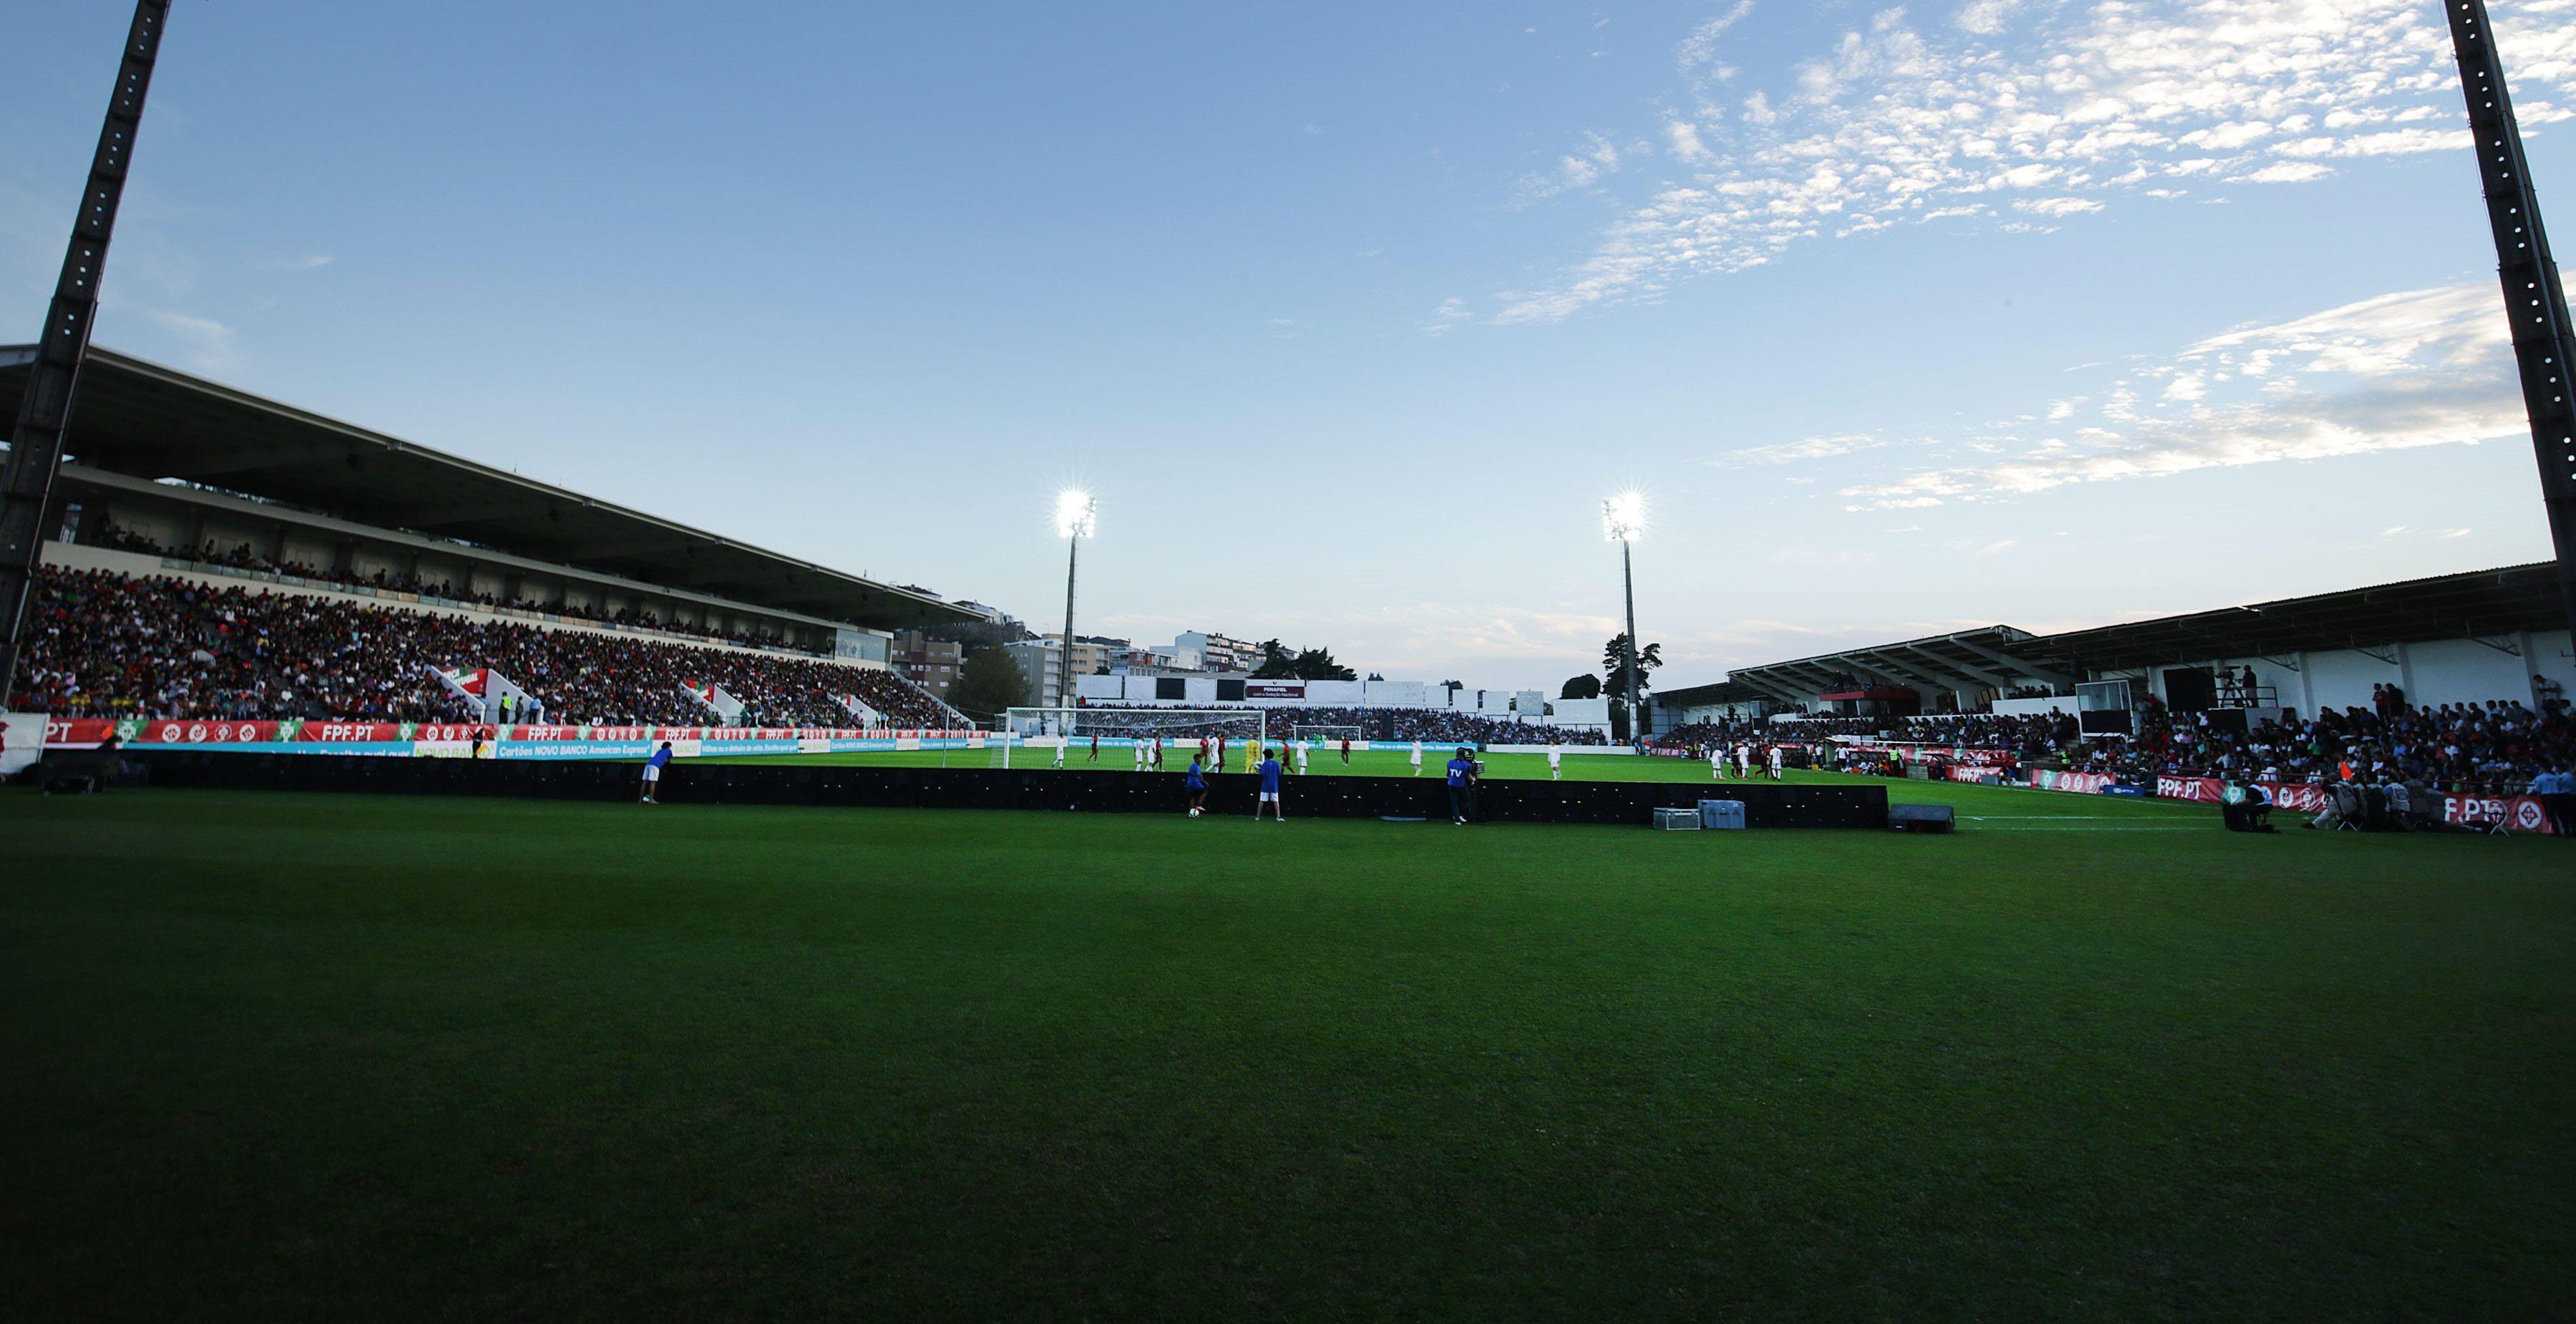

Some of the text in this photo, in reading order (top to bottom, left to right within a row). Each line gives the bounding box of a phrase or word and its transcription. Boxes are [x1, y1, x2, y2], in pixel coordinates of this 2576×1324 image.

[322, 724, 374, 741] FPF.PT
[528, 726, 562, 741] FPF.PT
[665, 729, 691, 740] FPF.PT
[766, 729, 784, 739] FPF.PT
[416, 748, 491, 758] NOVO BANO
[499, 745, 533, 756] Cartões
[535, 745, 559, 756] NOVO
[560, 745, 587, 755] BANCO
[589, 745, 622, 754] American
[1450, 769, 1462, 777] TV
[2157, 778, 2202, 800] FPF.PT
[2444, 797, 2492, 822] F.PT
